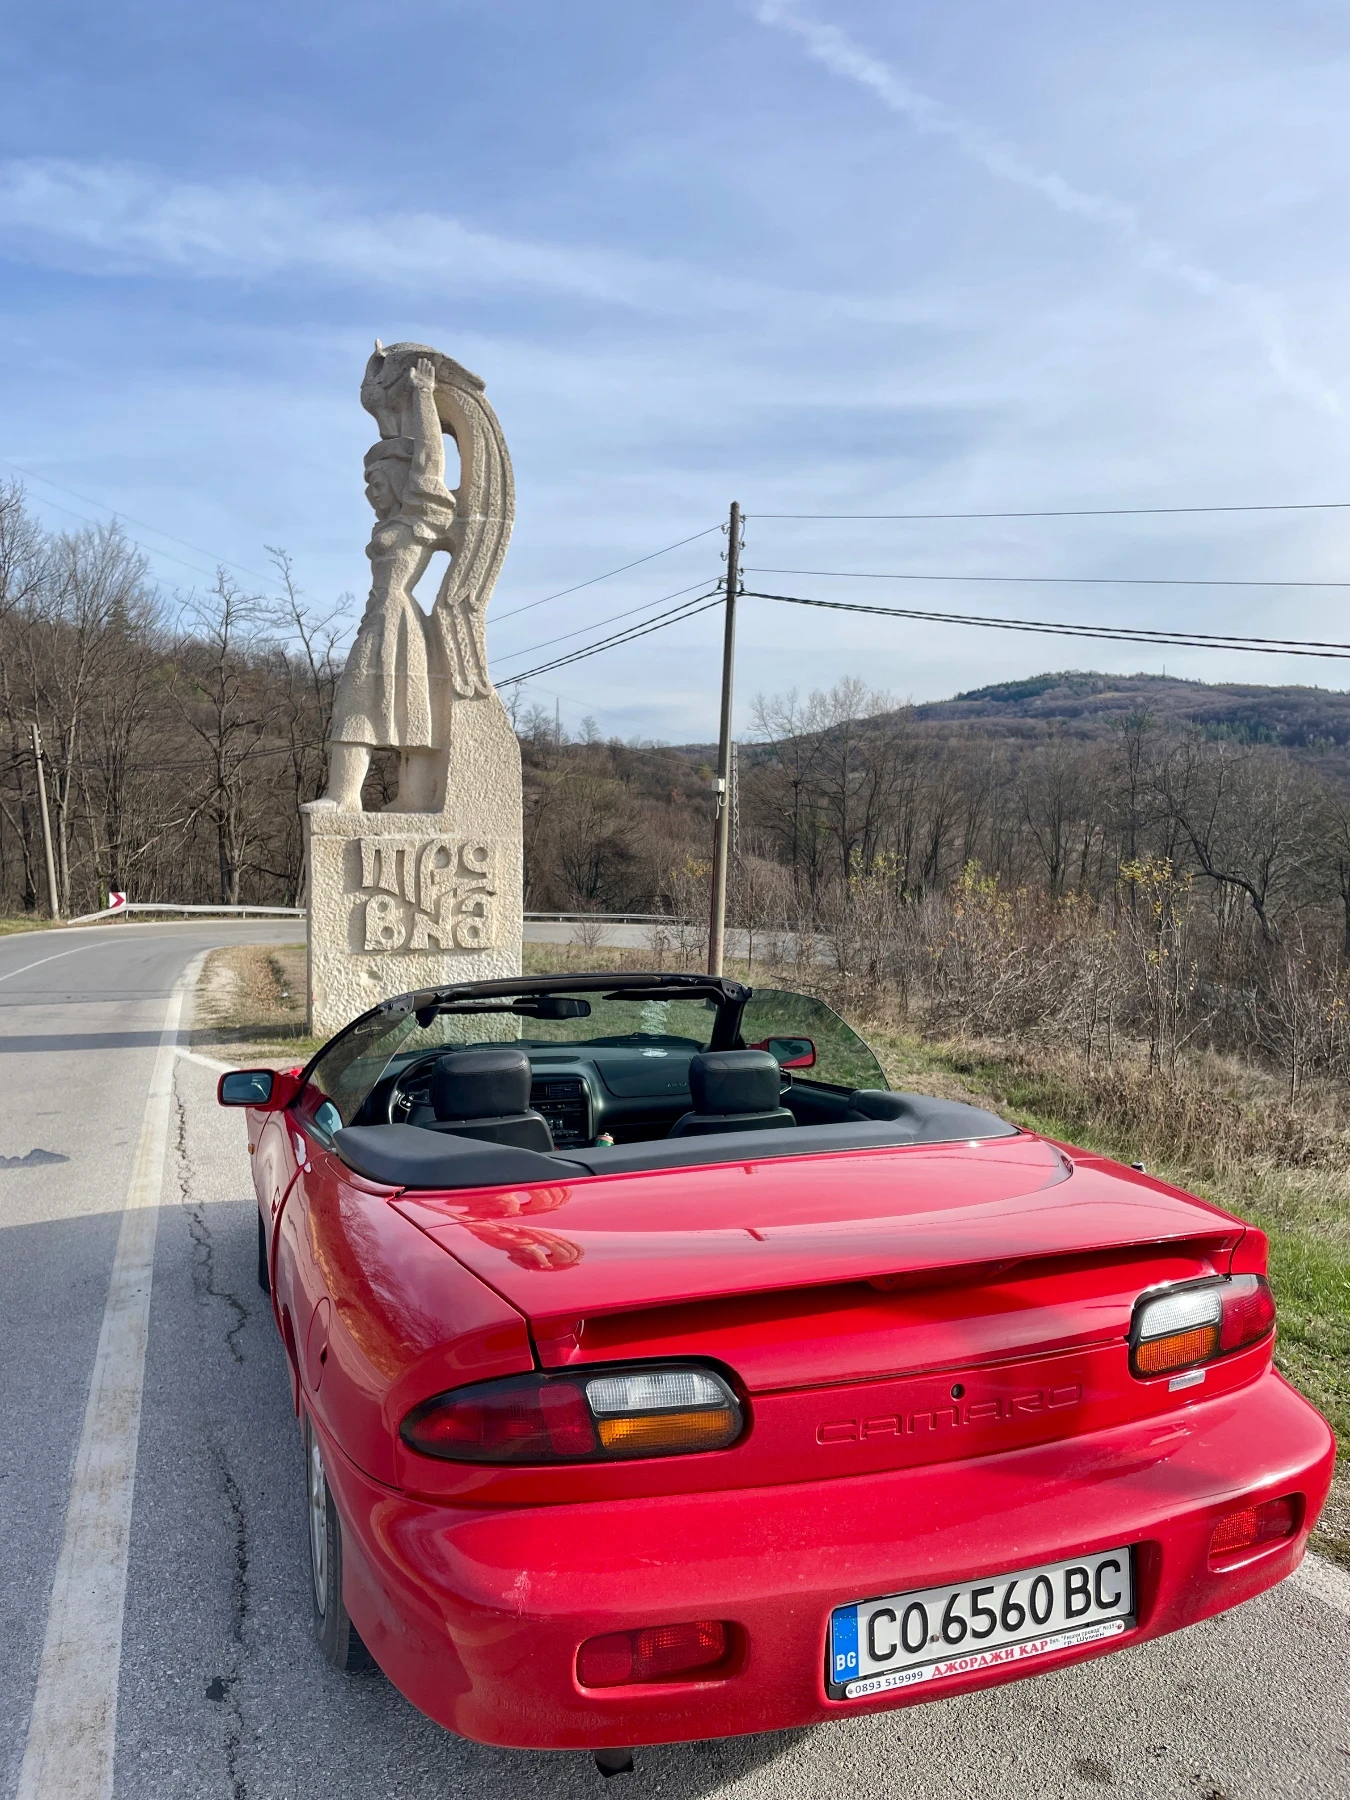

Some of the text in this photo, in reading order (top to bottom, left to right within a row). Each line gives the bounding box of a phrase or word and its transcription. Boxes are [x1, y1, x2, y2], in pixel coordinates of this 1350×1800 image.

[816, 1383, 1082, 1445] CAMARO
[941, 1574, 1054, 1645] 6560
[1065, 1559, 1122, 1620] BC
[836, 1651, 857, 1671] BG
[931, 1639, 1048, 1678] ДЖОРДЖИ КАР
[855, 1670, 923, 1694] 0893 519999
